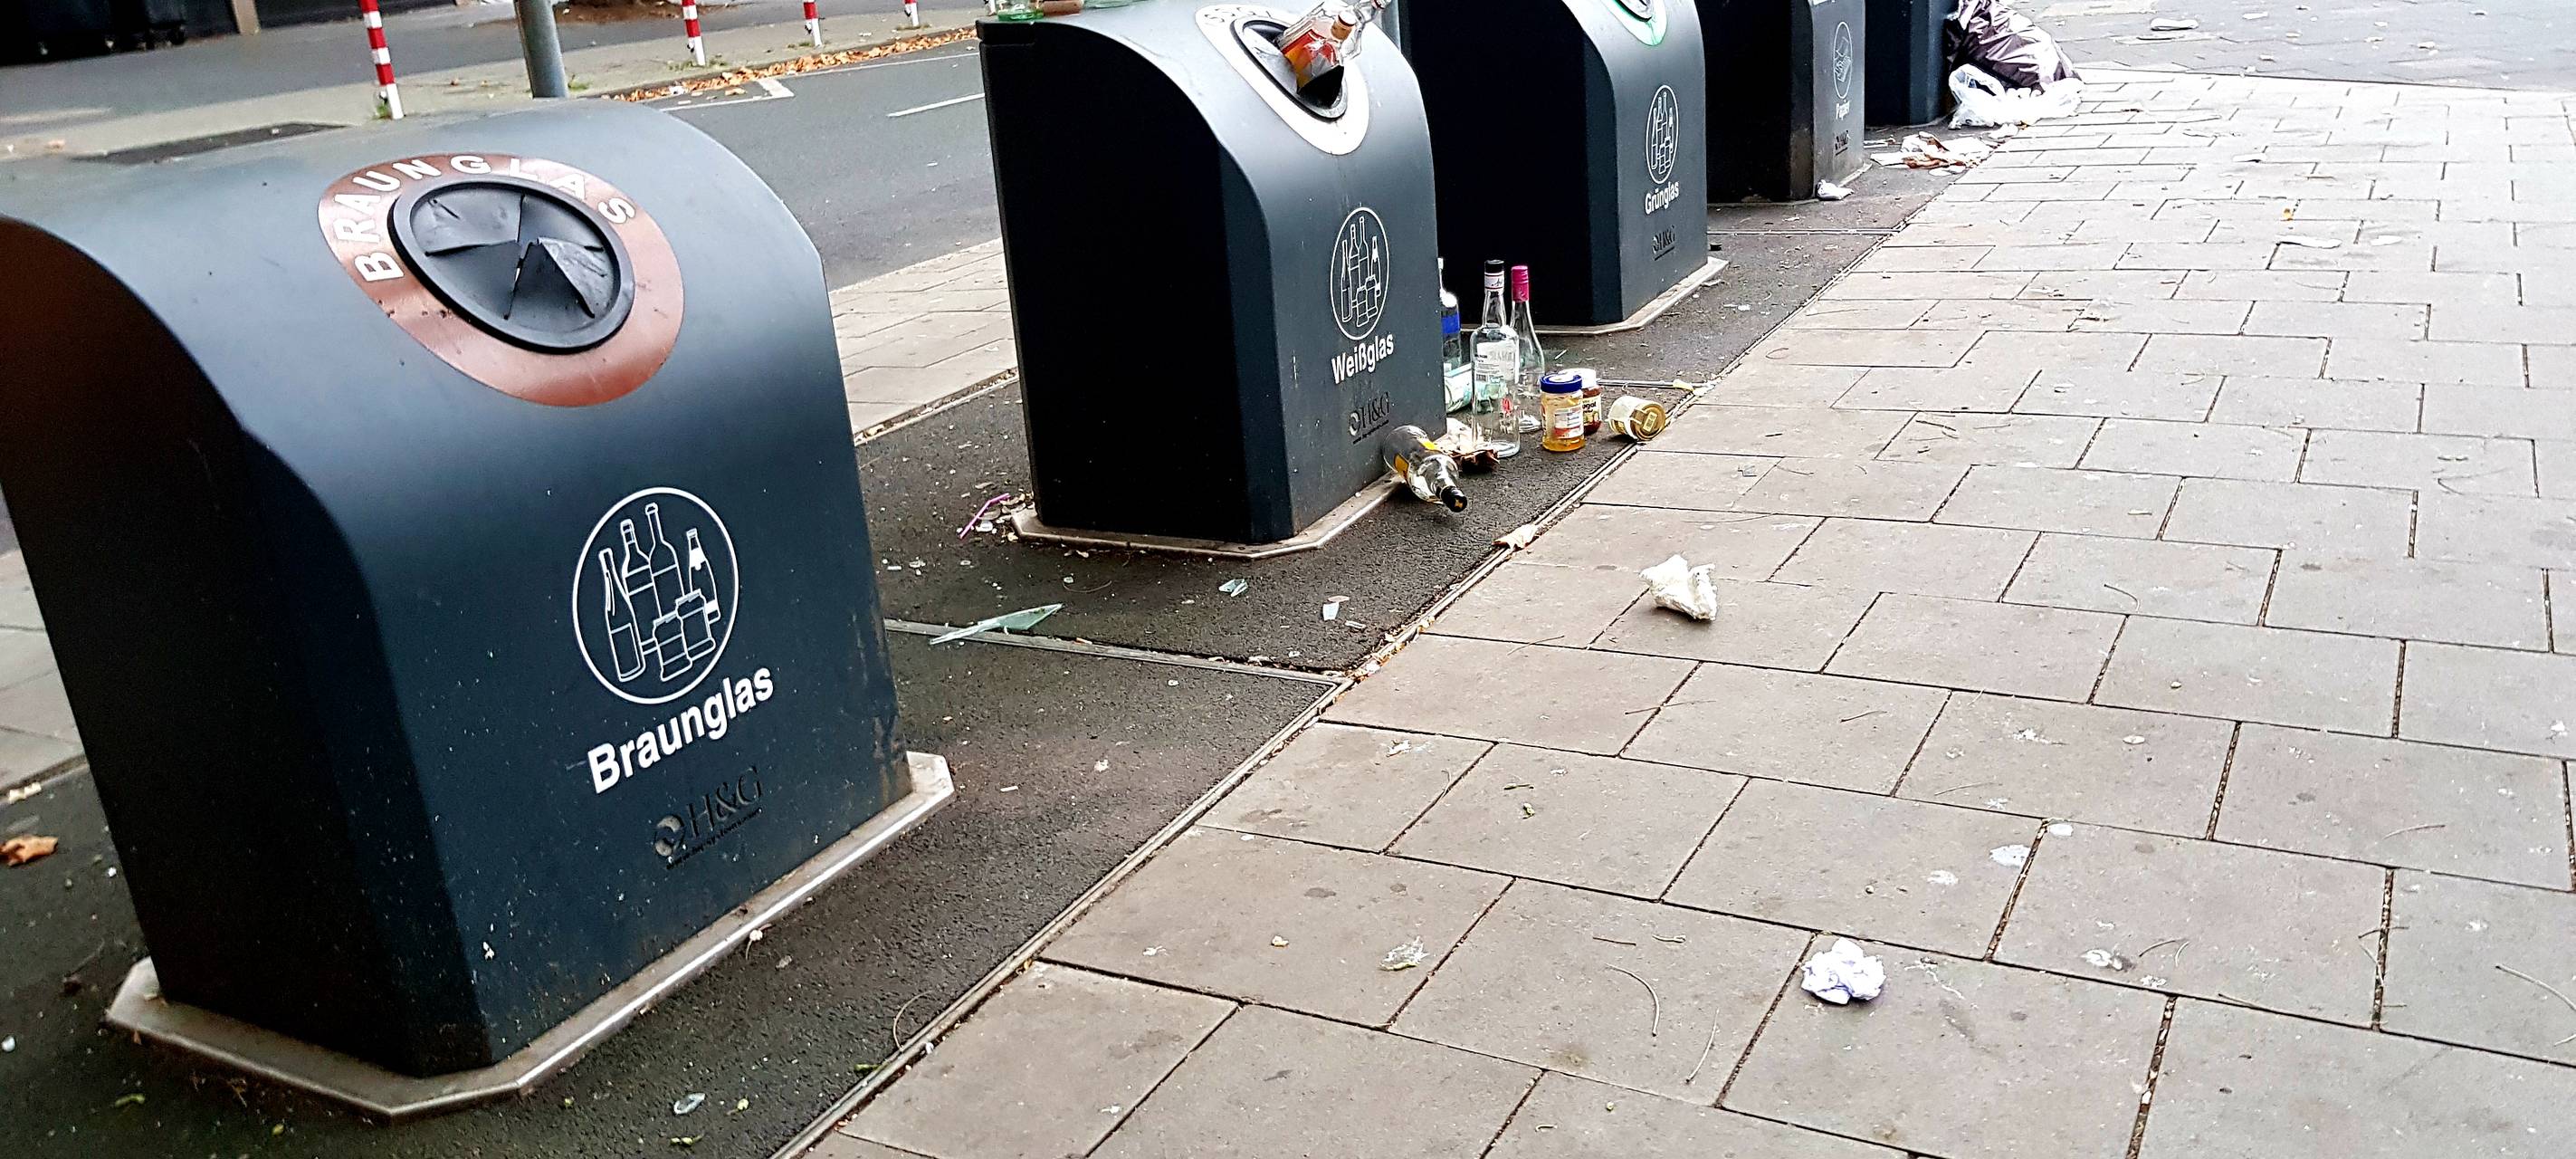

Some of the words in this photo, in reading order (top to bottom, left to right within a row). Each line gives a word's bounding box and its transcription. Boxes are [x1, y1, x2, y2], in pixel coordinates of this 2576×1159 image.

[331, 154, 635, 283] BRAUNGLAS
[1645, 181, 1679, 215] Grünglas
[1331, 333, 1394, 385] Weißglas
[587, 667, 774, 794] Braunglas
[687, 765, 762, 840] H&G
